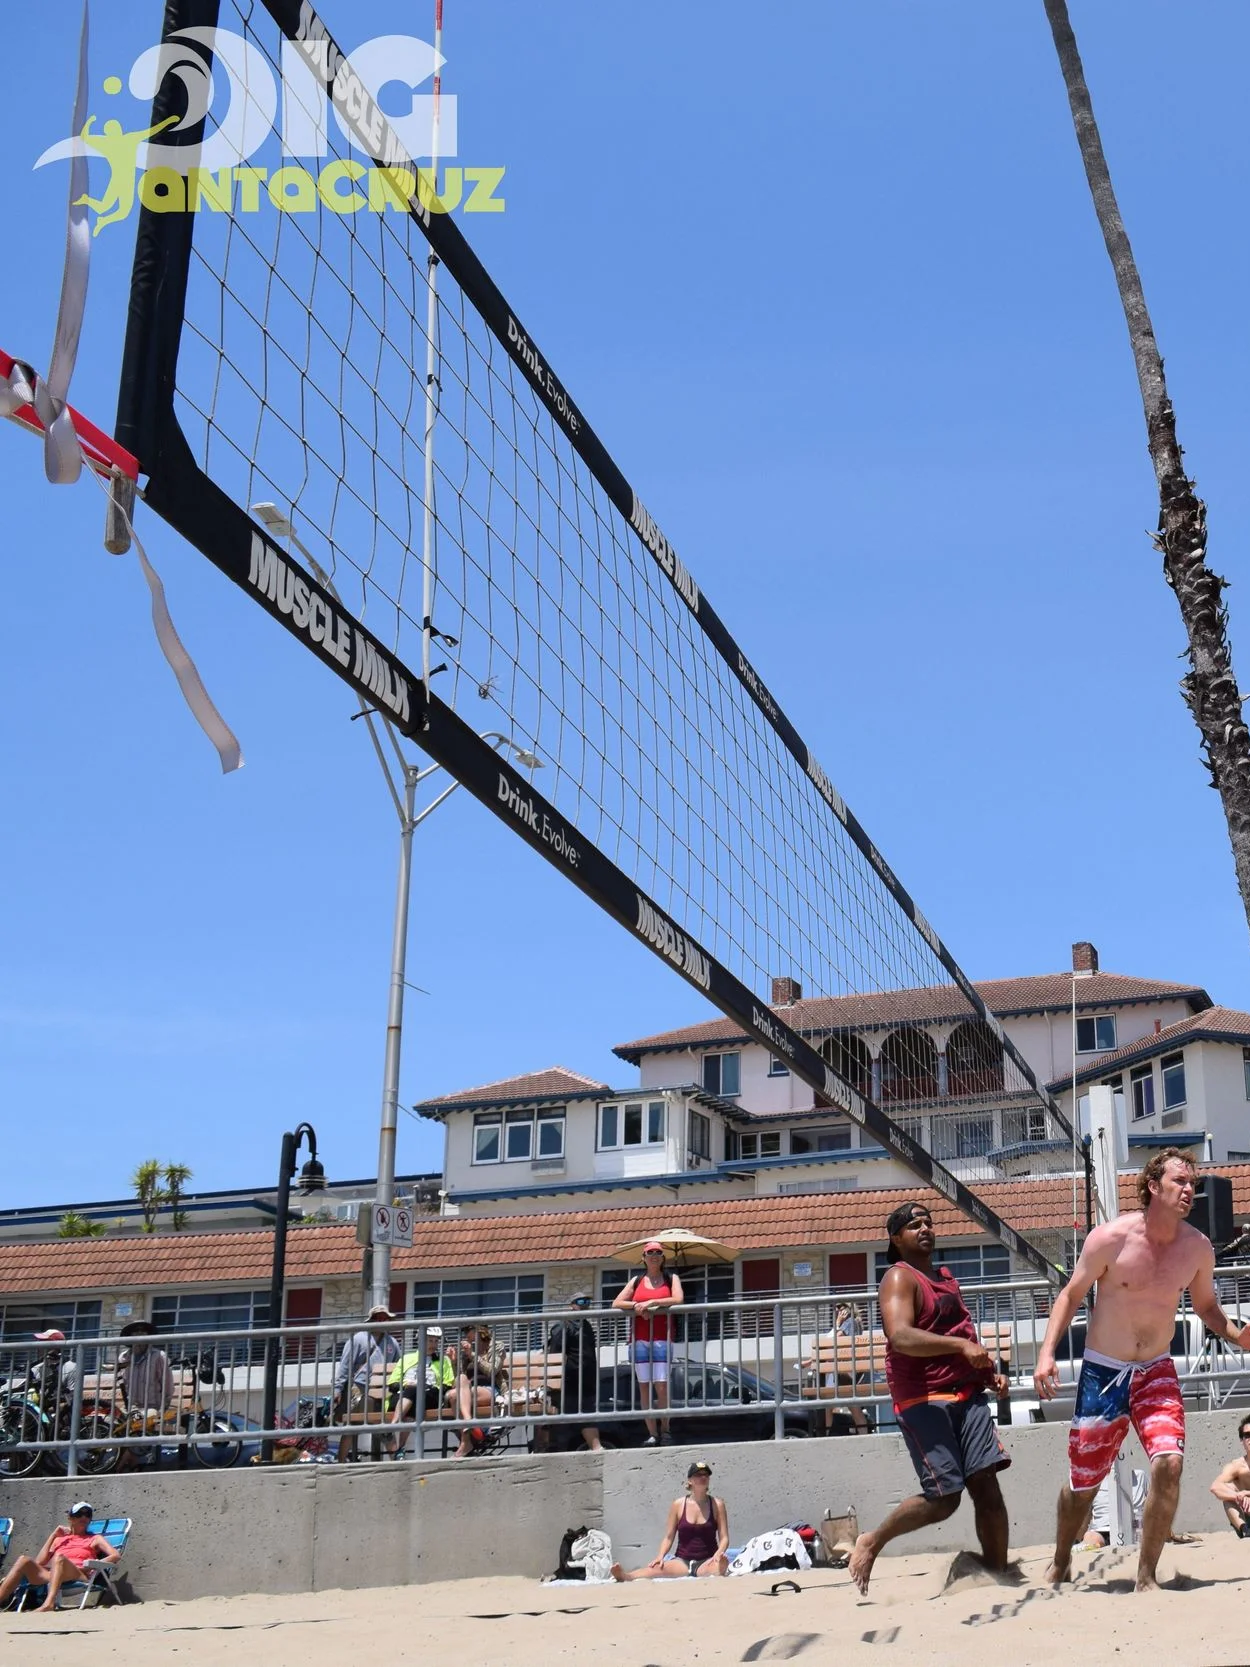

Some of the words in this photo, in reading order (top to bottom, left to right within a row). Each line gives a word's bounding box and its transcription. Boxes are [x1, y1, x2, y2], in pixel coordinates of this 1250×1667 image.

[507, 314, 546, 387] Drink.
[630, 489, 676, 578] MUSCLE
[673, 555, 700, 614] MILK
[248, 530, 351, 668] MUSCLE
[352, 628, 411, 723] MILK
[497, 773, 541, 834] Drink.
[635, 893, 684, 967] MUSCLE
[682, 935, 711, 991] MILK
